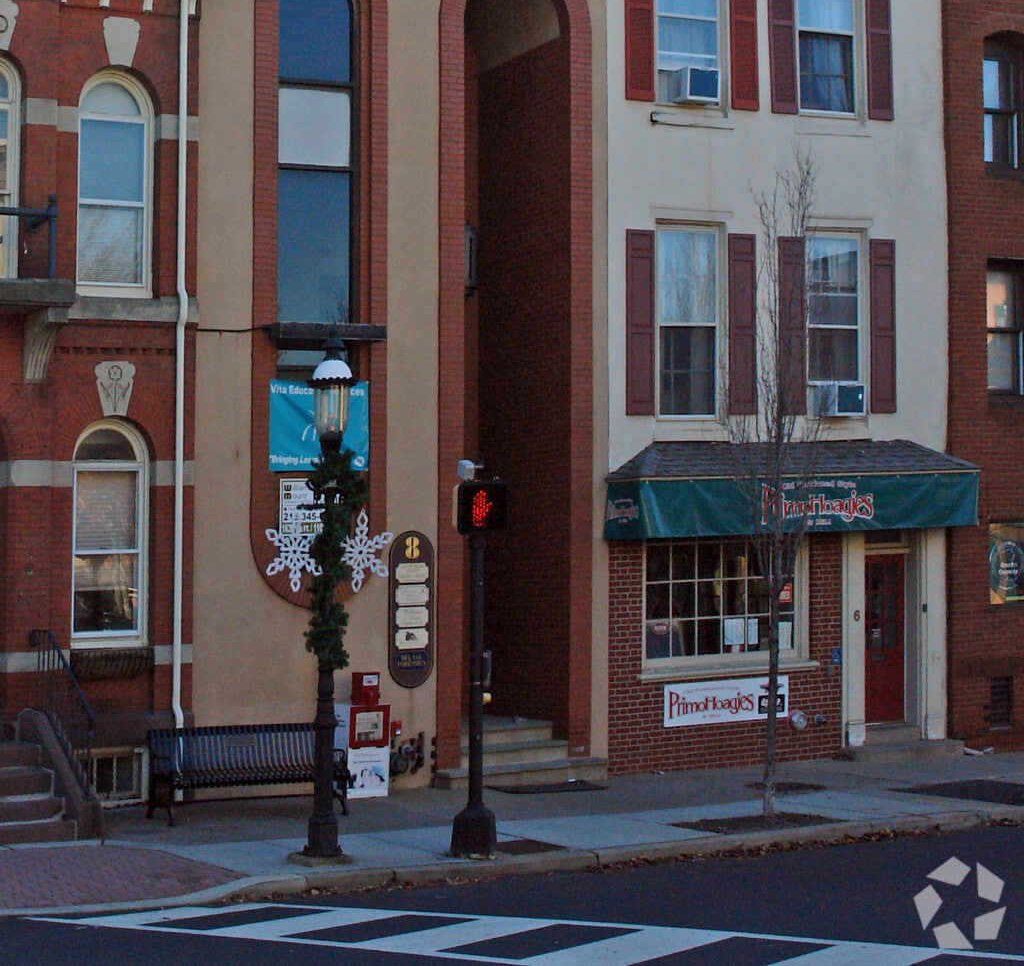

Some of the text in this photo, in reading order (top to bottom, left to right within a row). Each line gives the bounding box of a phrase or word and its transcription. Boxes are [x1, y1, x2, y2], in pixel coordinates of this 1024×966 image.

[762, 483, 874, 525] PrmoHoagies
[405, 536, 420, 559] 8
[854, 610, 861, 622] 6
[668, 691, 754, 720] PrimoHoagies
